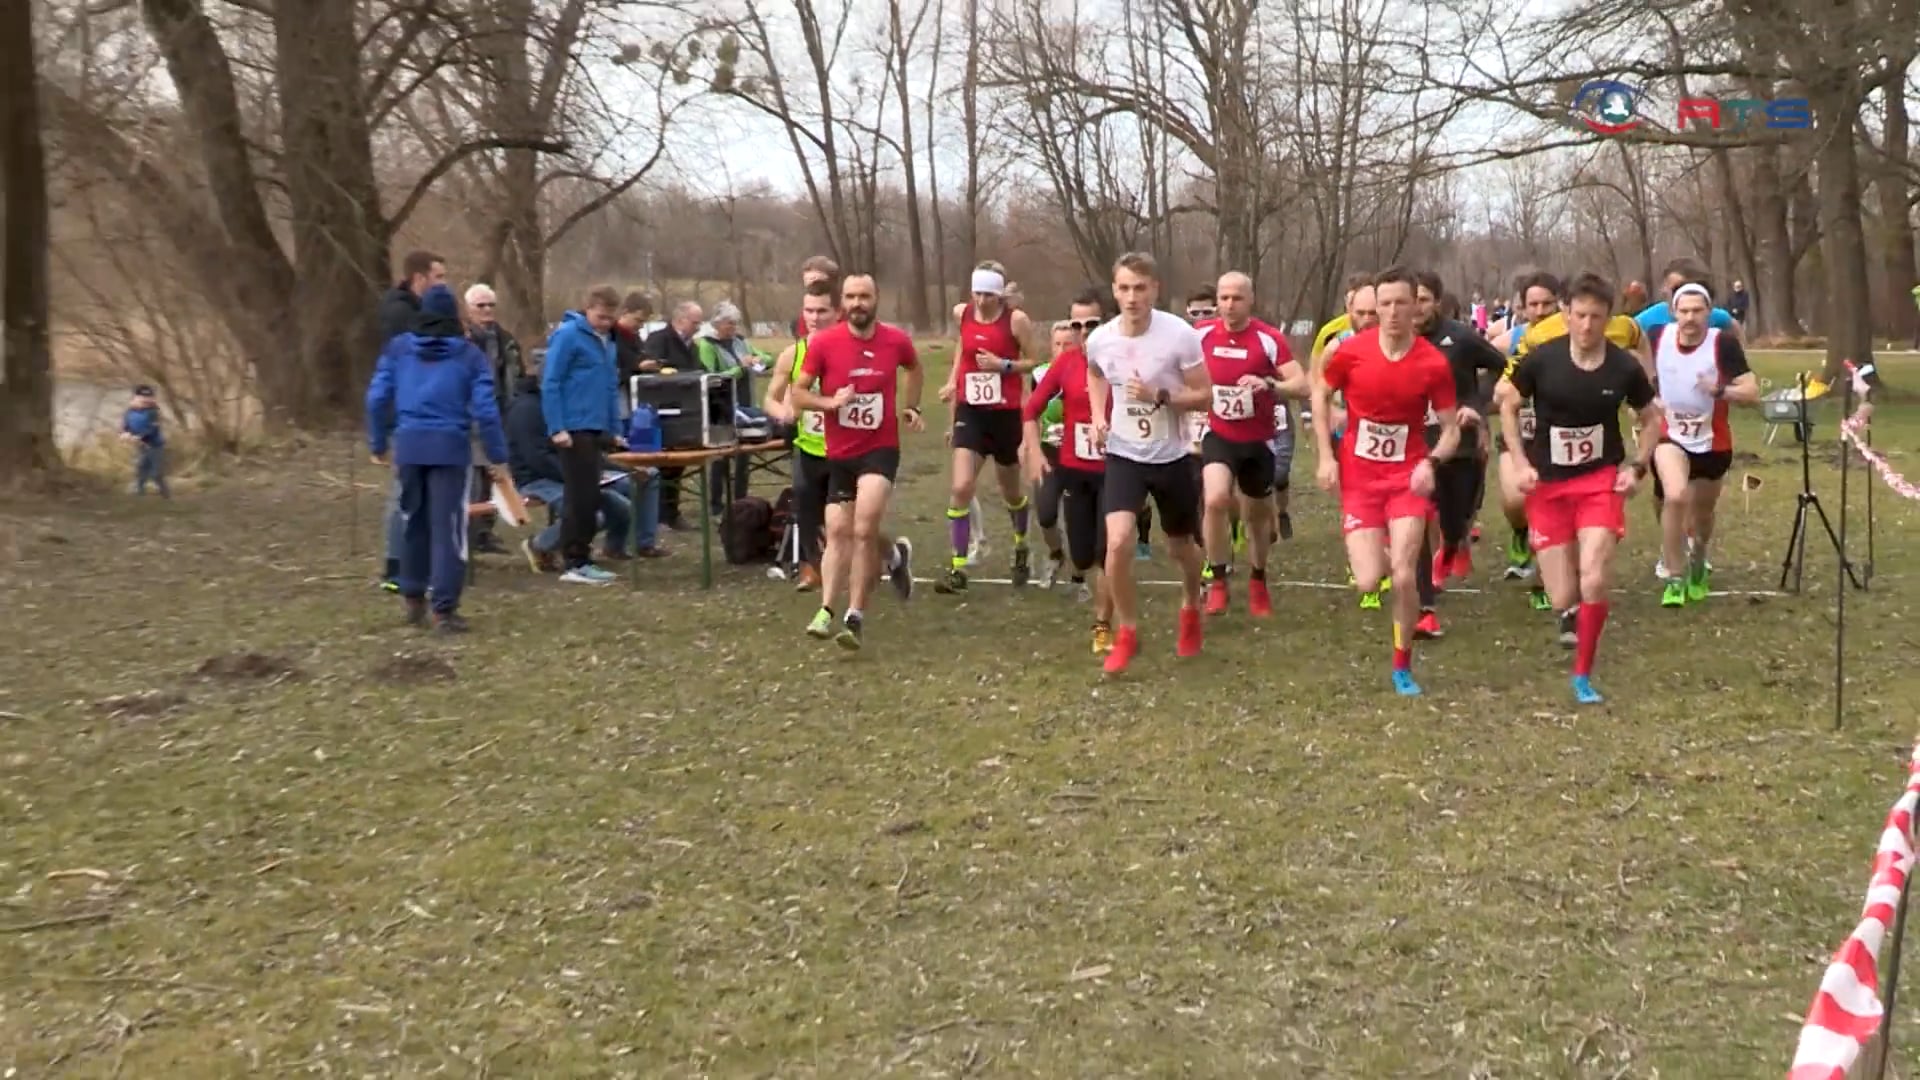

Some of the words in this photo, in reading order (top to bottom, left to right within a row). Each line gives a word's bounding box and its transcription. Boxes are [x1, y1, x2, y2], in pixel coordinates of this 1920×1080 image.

[974, 384, 993, 401] 30
[847, 407, 874, 426] 46
[1220, 399, 1244, 417] 24
[1138, 418, 1151, 438] 9
[1678, 421, 1703, 438] 27
[1366, 436, 1396, 457] 20
[1563, 441, 1594, 462] 19
